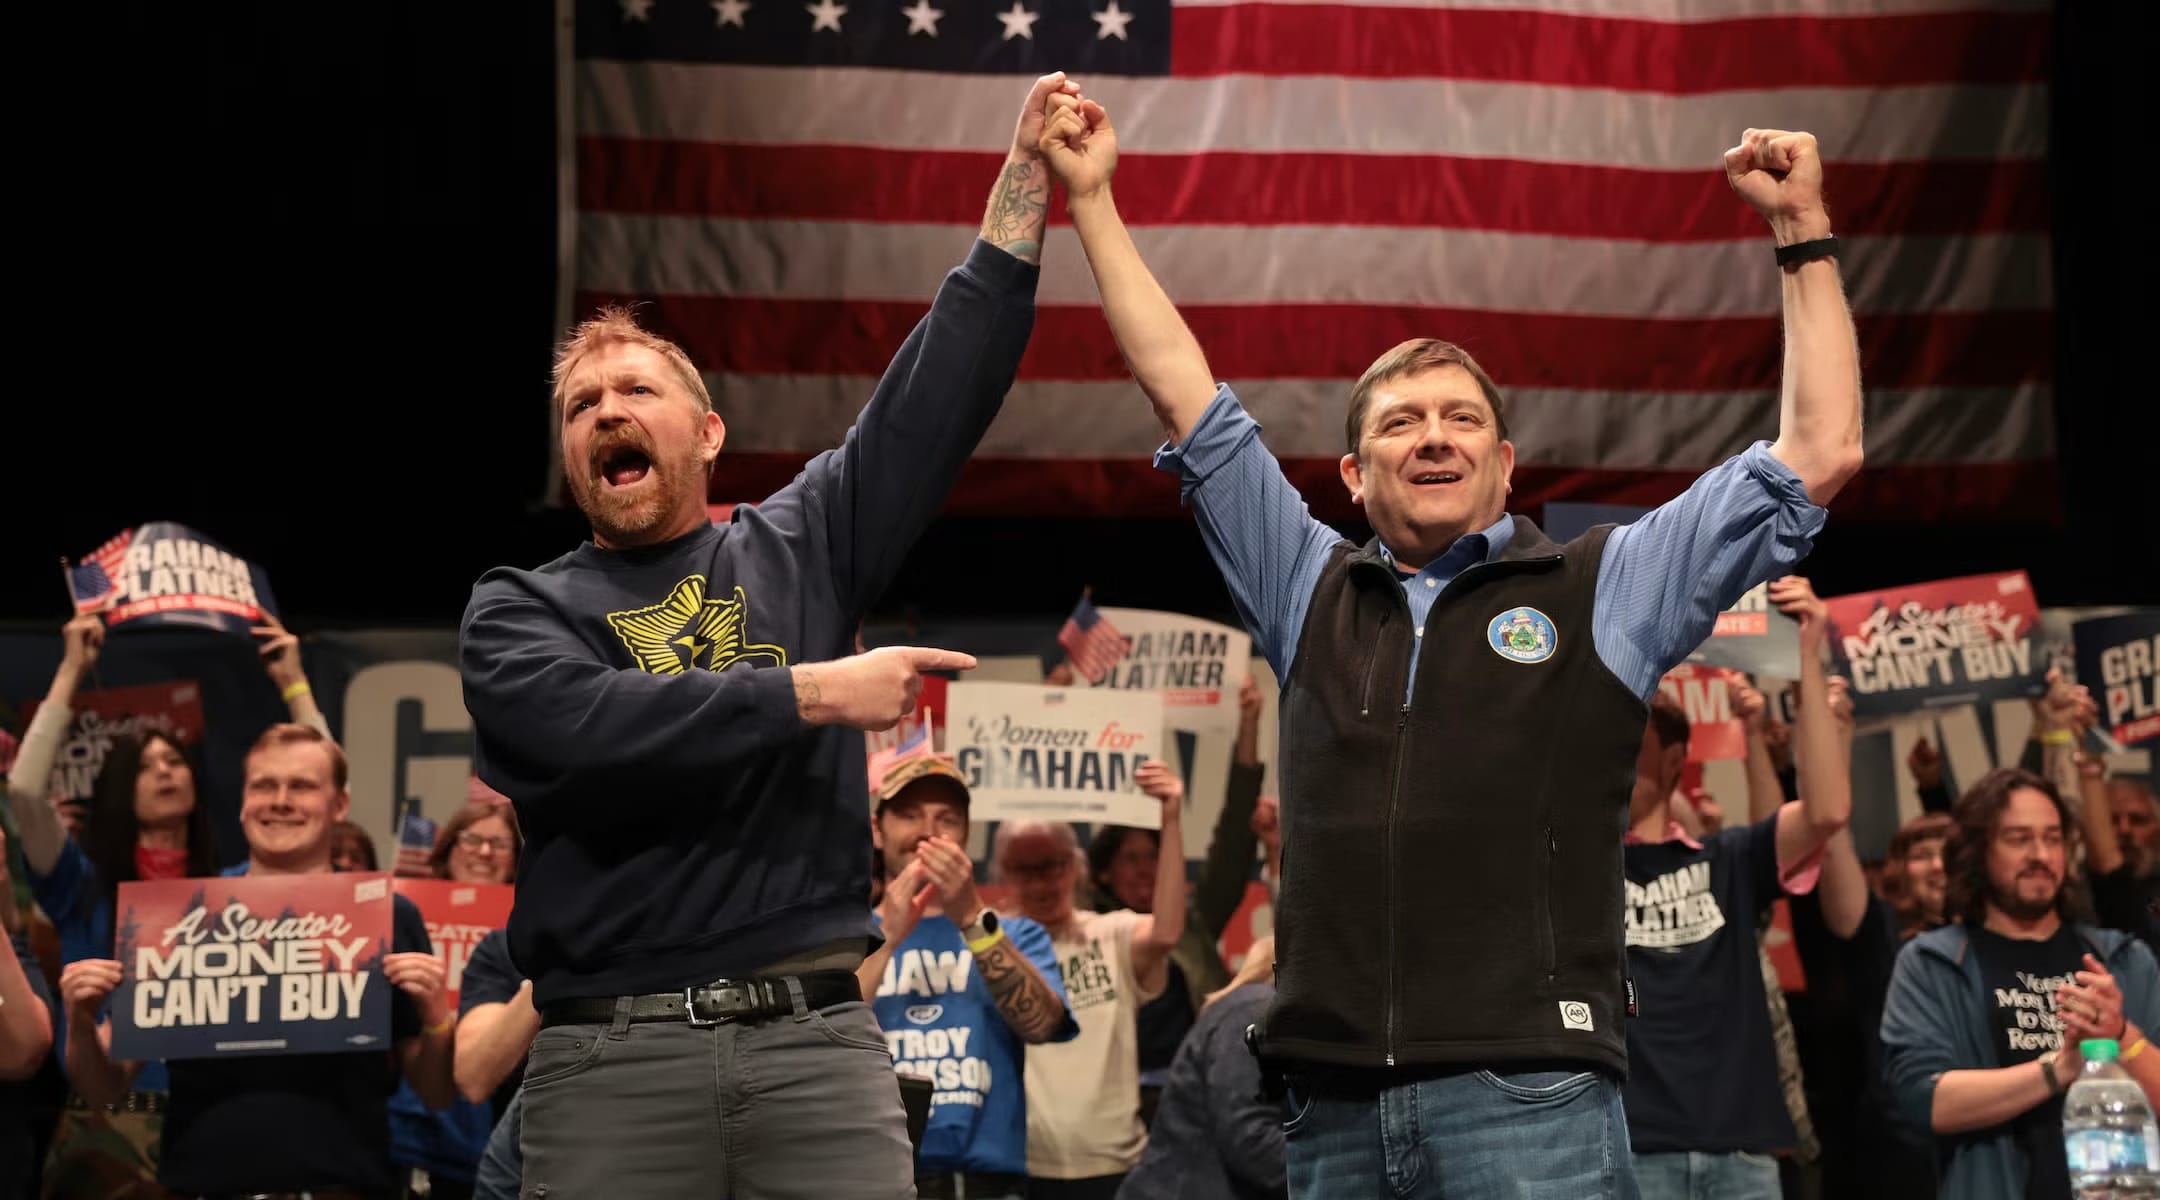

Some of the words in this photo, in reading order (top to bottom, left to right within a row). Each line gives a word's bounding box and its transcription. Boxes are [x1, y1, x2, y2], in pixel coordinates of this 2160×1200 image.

[123, 538, 251, 582] RAHAM
[1126, 630, 1228, 659] AHAM
[1842, 613, 2023, 659] MONEY
[1091, 661, 1224, 688] LATNER
[1851, 650, 1954, 695] CAN'T
[1960, 638, 2031, 682] BUY
[1097, 720, 1144, 750] for
[1625, 861, 1710, 906] RAHAM
[161, 906, 209, 947] A
[213, 903, 352, 945] Senator
[1625, 891, 1723, 931] LATNER
[135, 937, 369, 981] MONEY
[133, 975, 268, 1029] CAN'T
[280, 971, 369, 1021] BUY
[2016, 1008, 2039, 1029] to
[885, 1027, 971, 1061] TROY
